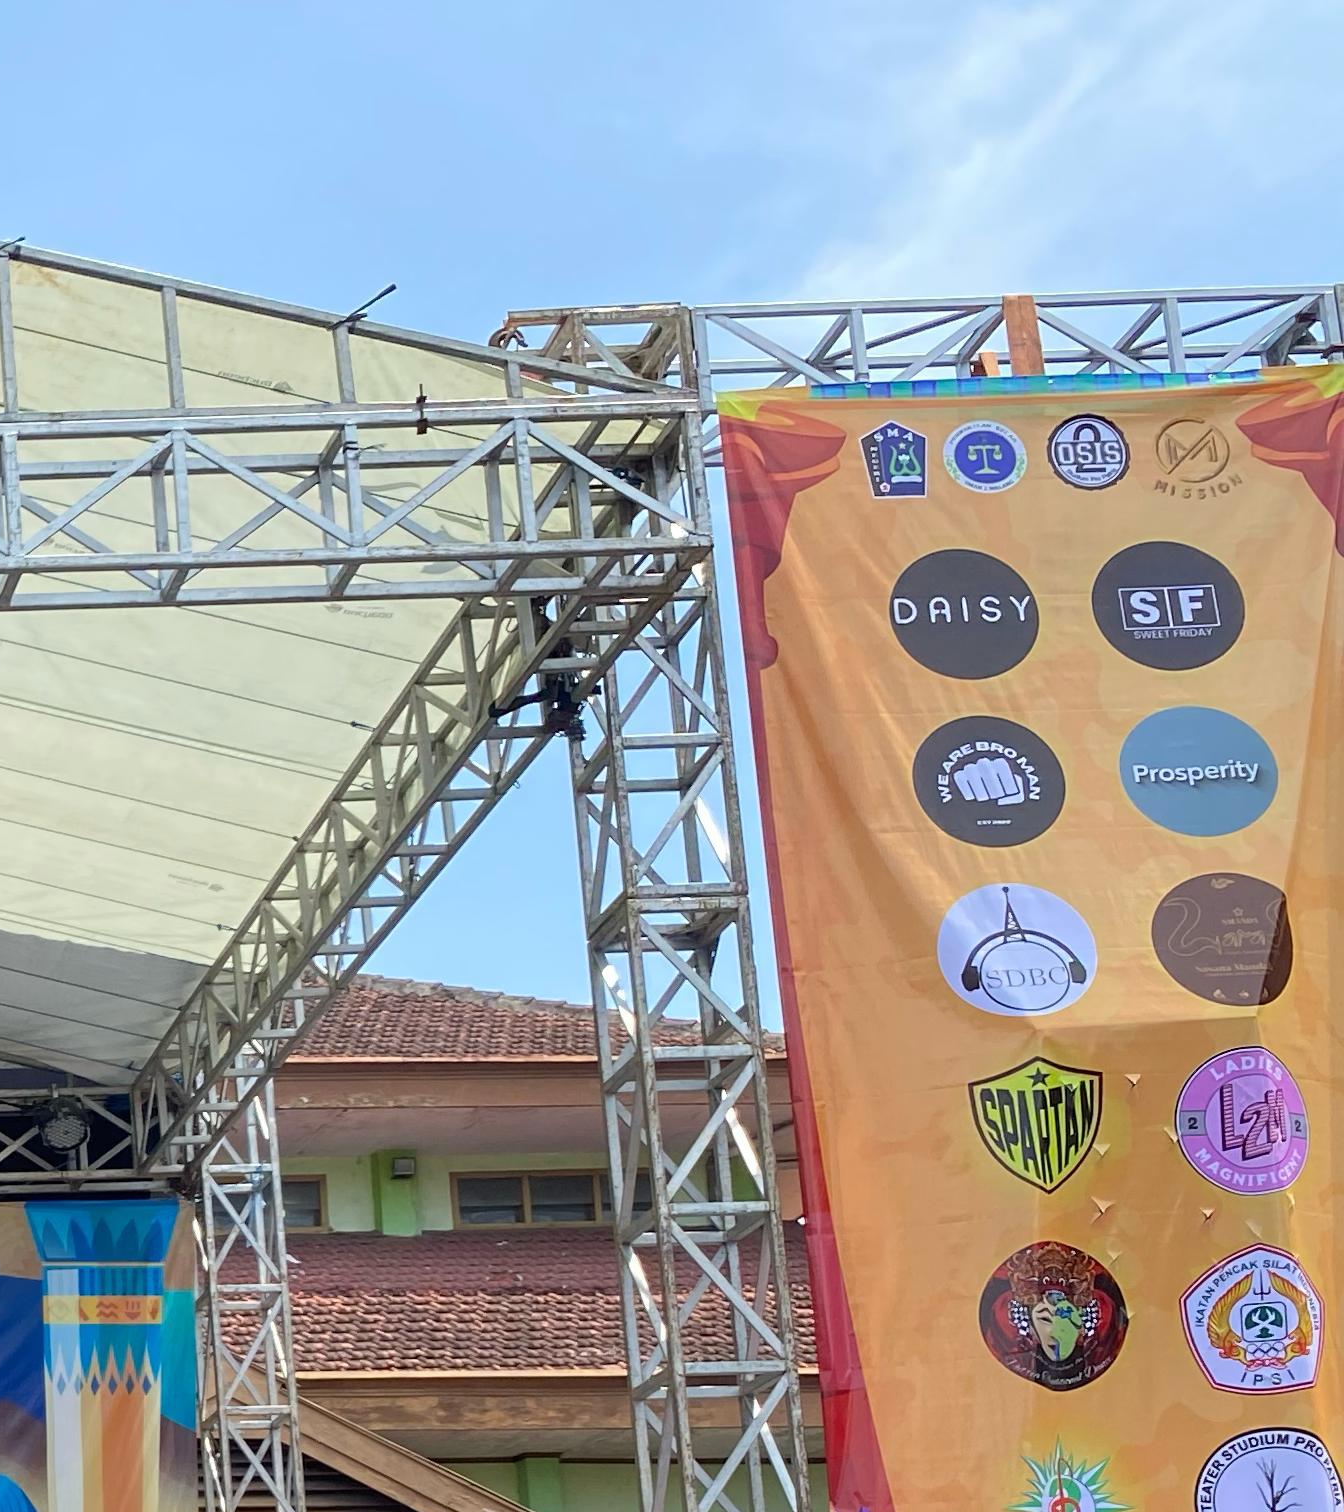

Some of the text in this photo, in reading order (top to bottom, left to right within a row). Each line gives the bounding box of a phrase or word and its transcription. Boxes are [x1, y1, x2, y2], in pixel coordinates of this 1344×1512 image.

[1059, 442, 1121, 464] OSIS
[1153, 474, 1242, 499] MISSION
[894, 595, 1031, 625] DAISY
[1133, 627, 1213, 640] SWEET FRIDAY
[938, 741, 1041, 803] WE ARE BRO MAN
[1132, 760, 1259, 786] Prosperity
[986, 966, 1066, 988] SDBC
[1210, 1054, 1283, 1081] LADIES
[979, 1079, 1095, 1185] SPARTAN
[1195, 1259, 1297, 1328] IKATAN PENCAK SILAT
[1240, 1369, 1296, 1386] IPSI
[1200, 1433, 1341, 1512] TEATER STUDIUM PRO PATRIA
